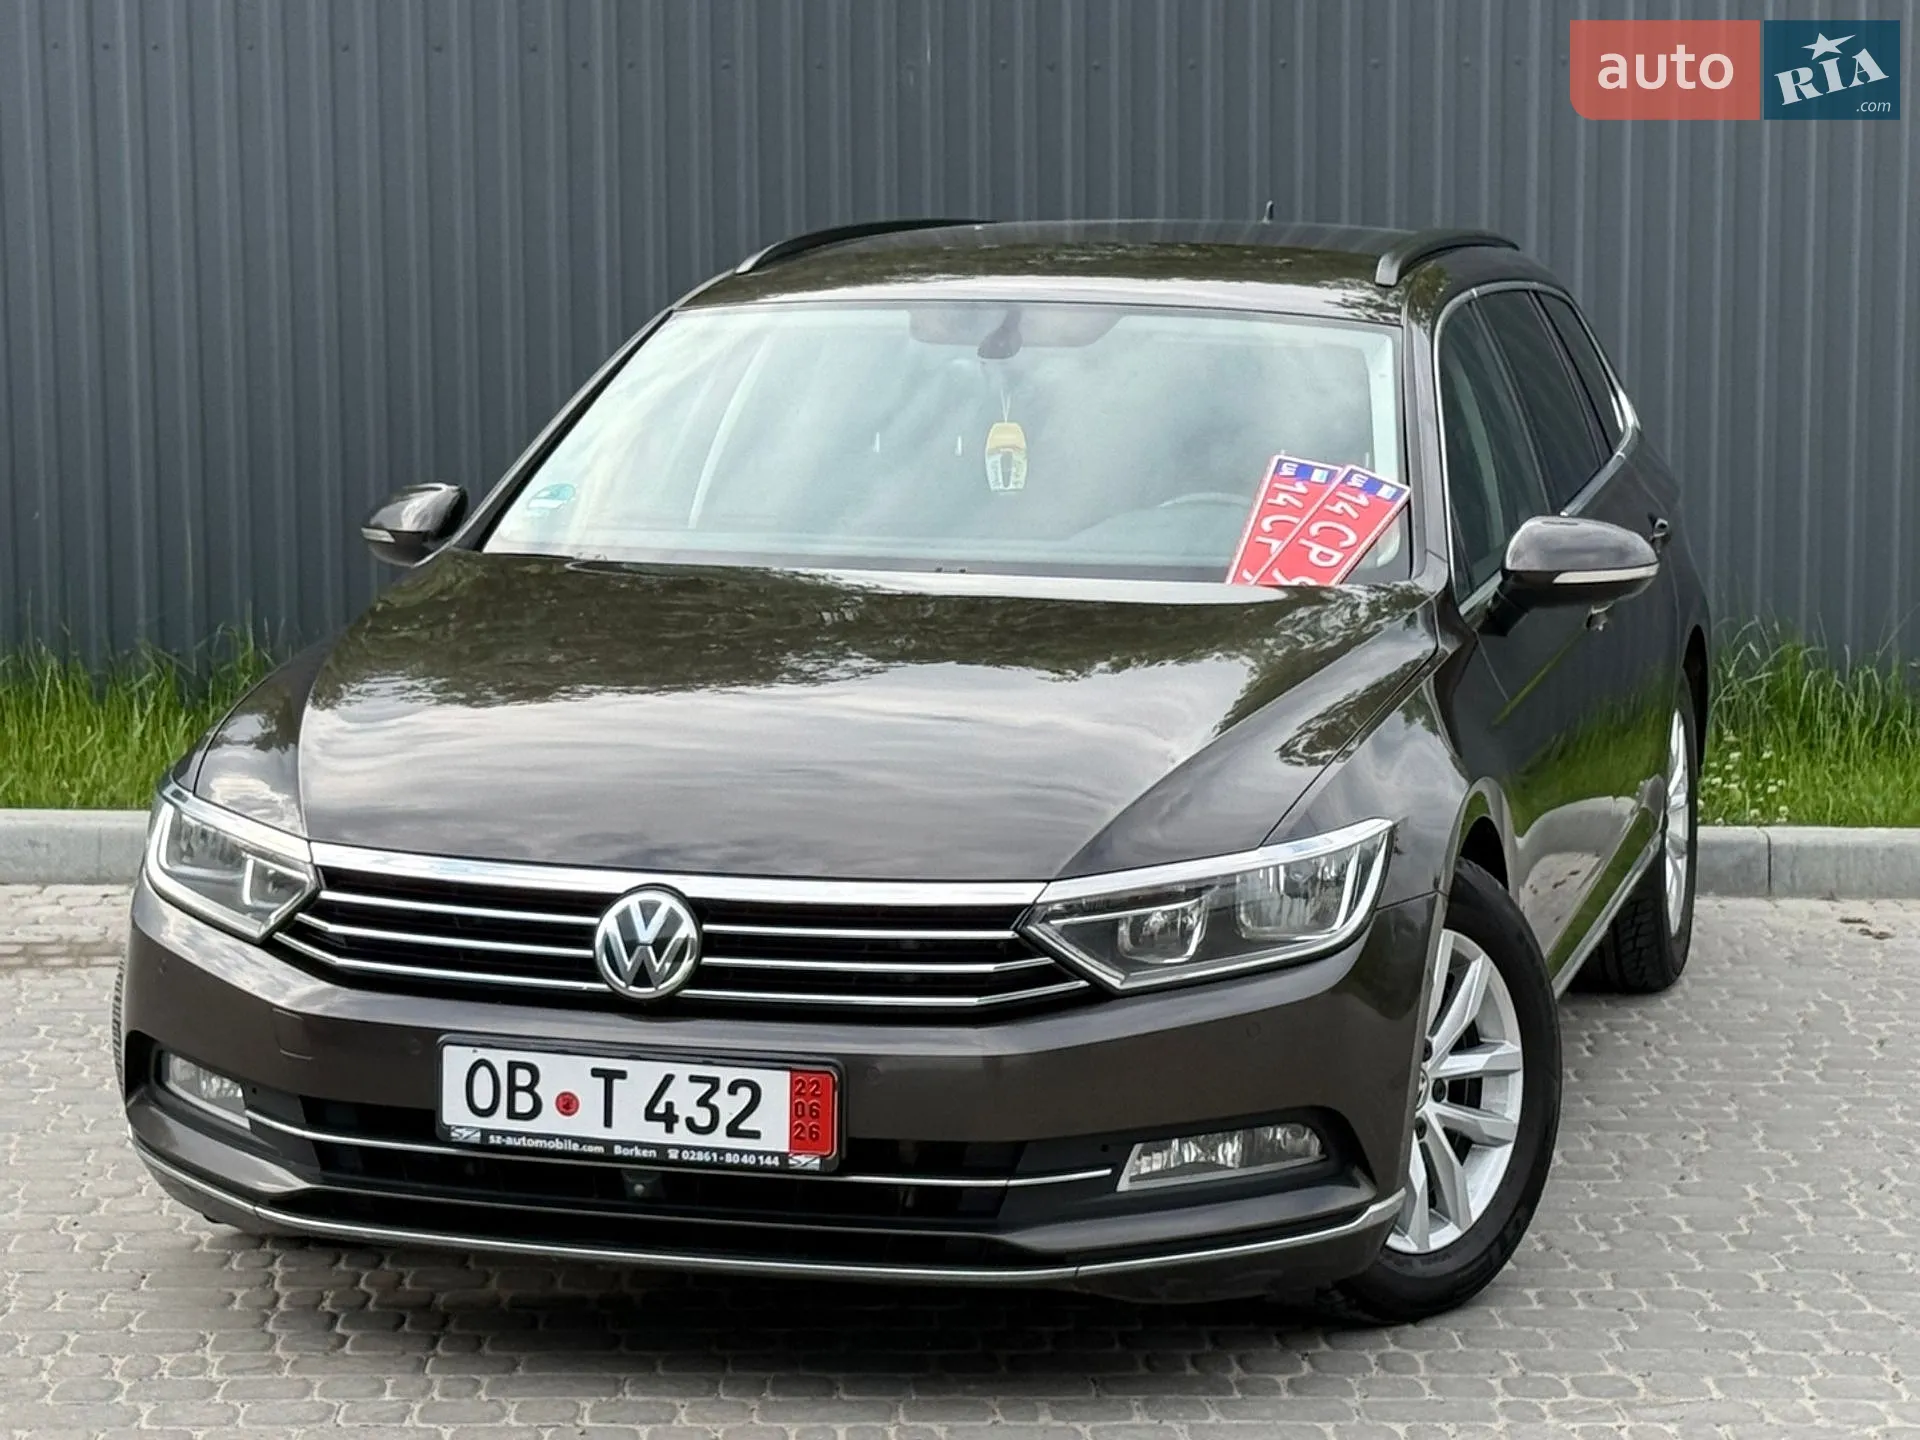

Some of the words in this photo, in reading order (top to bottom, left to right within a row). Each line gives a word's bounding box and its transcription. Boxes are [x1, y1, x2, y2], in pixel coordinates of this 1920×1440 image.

[794, 1076, 822, 1097] 22
[465, 1057, 543, 1122] OB
[590, 1067, 627, 1129] T
[644, 1072, 762, 1140] 432
[794, 1098, 821, 1119] 06
[793, 1121, 821, 1141] 26
[488, 1134, 605, 1153] sz-automobile.com
[614, 1144, 657, 1158] Borken
